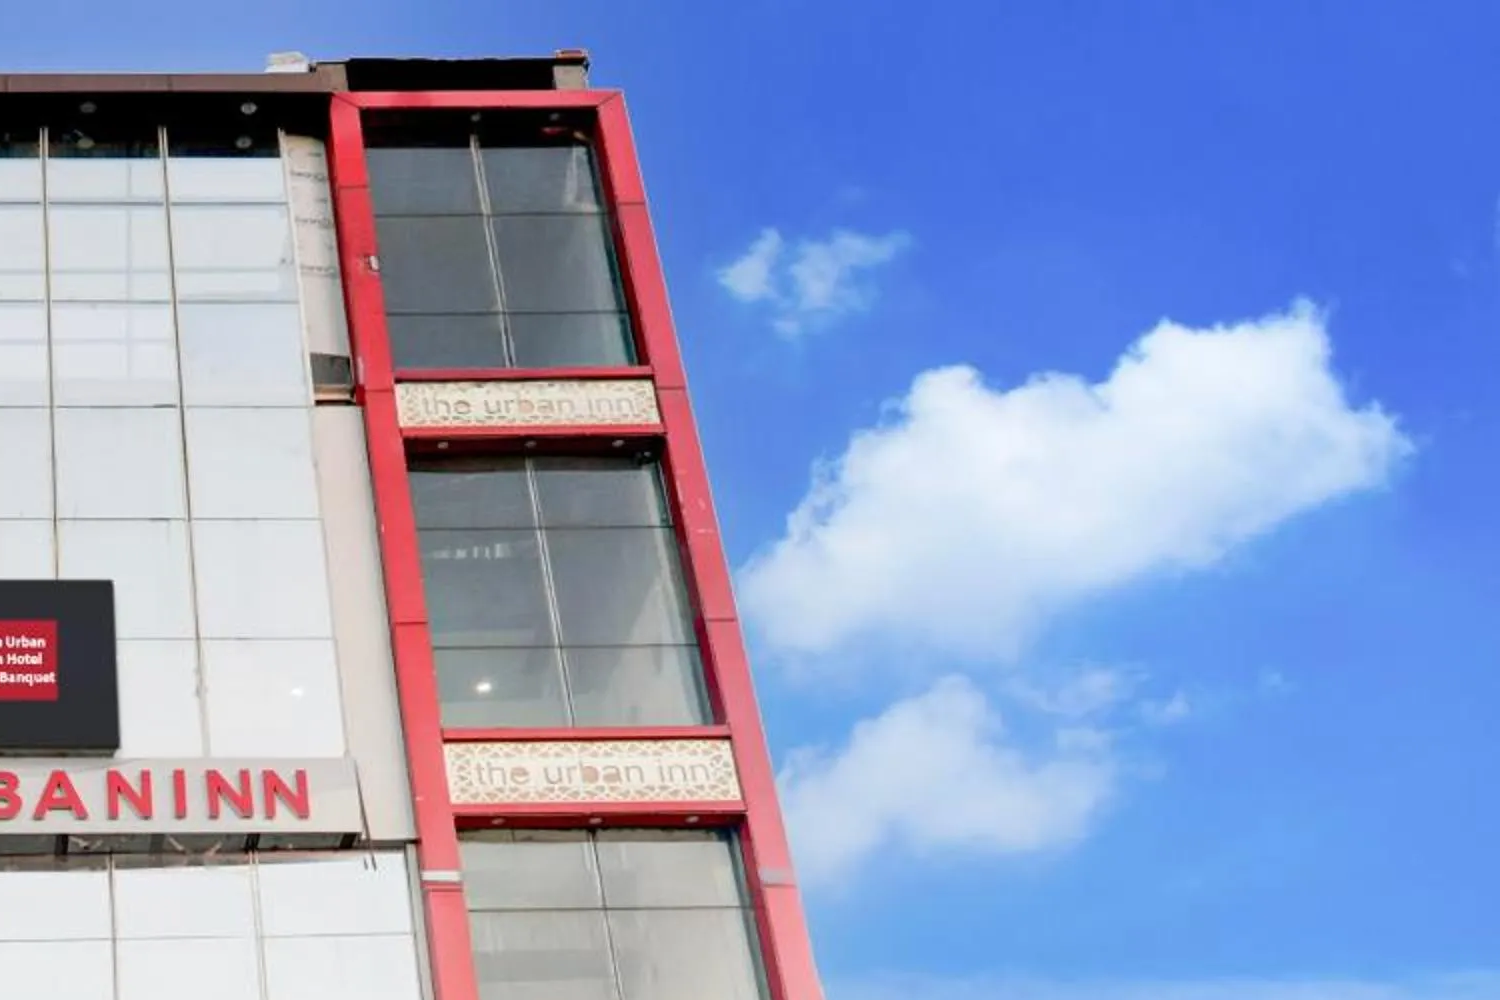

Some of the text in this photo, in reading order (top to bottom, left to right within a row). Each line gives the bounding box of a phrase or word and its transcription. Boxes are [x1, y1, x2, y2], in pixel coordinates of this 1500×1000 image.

[423, 394, 635, 416] the urban inn
[5, 634, 46, 649] Urban
[7, 651, 43, 665] Hotel
[0, 671, 56, 687] Banquet
[474, 759, 711, 786] the urban inn
[172, 768, 311, 820] INN
